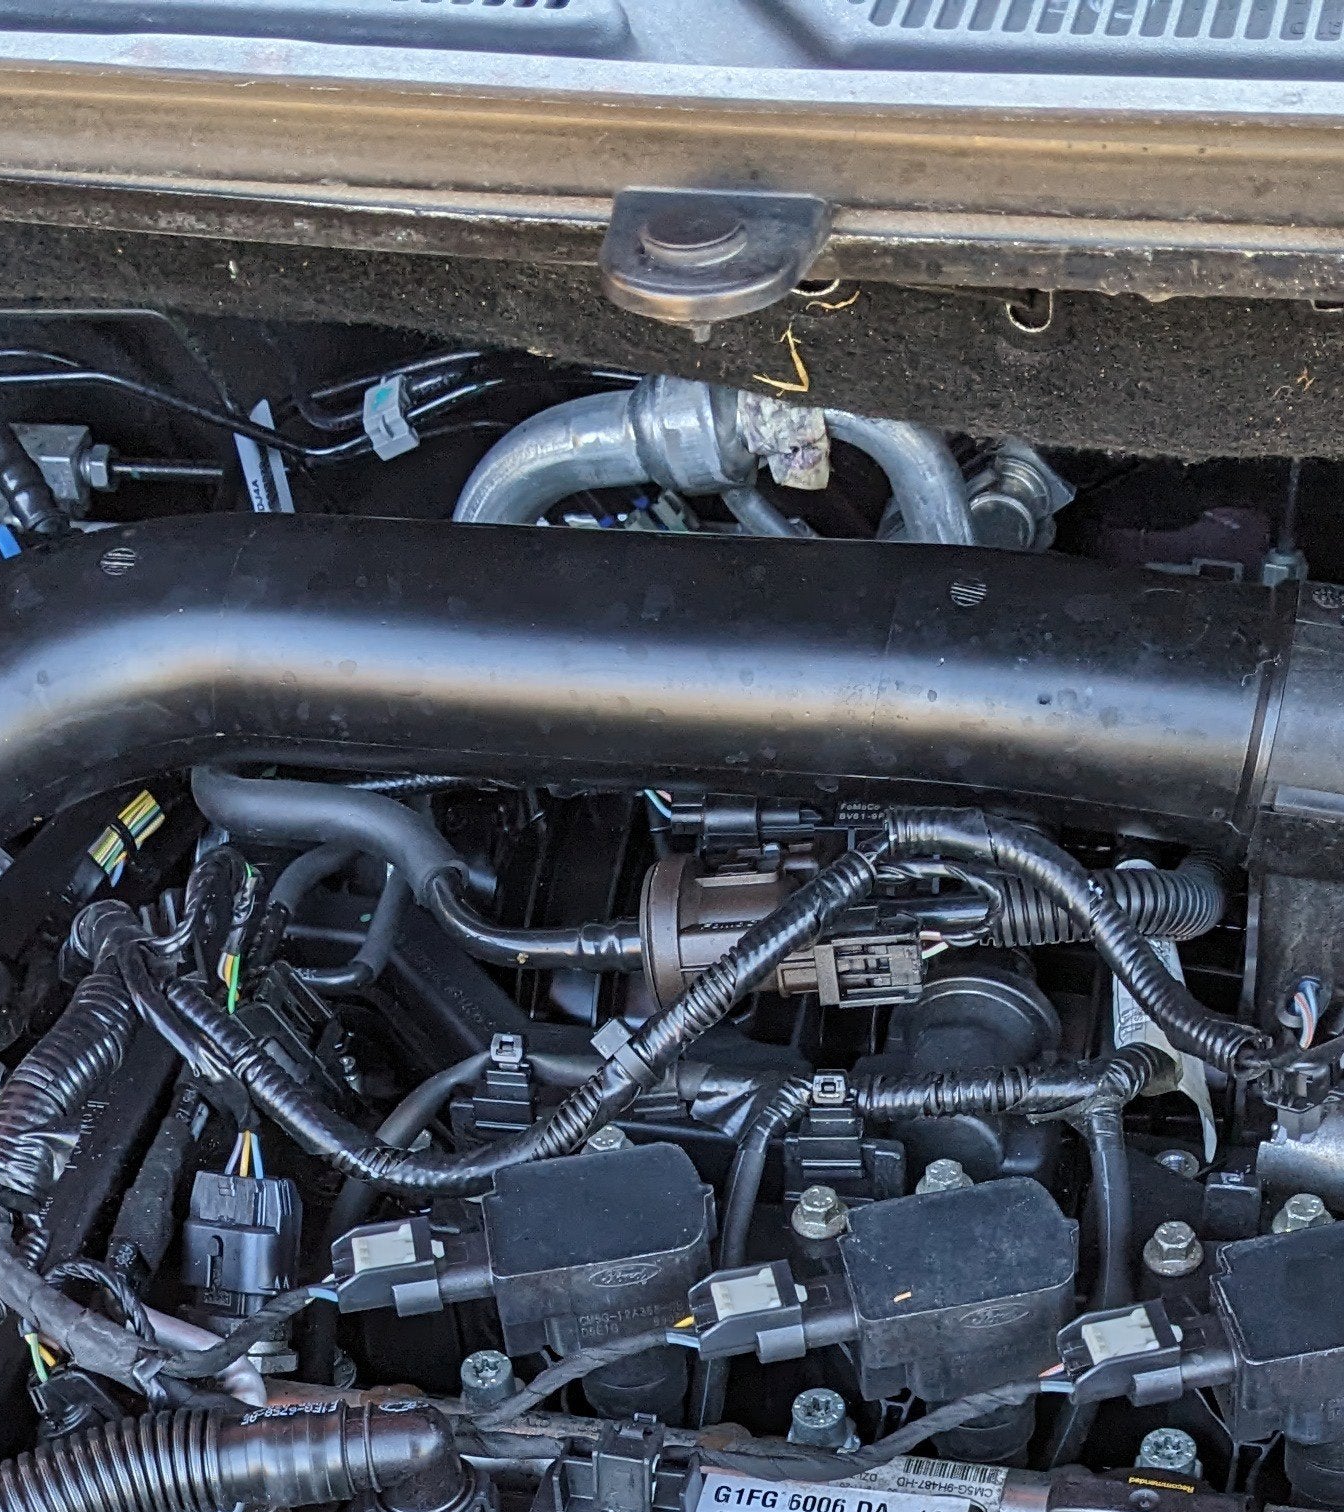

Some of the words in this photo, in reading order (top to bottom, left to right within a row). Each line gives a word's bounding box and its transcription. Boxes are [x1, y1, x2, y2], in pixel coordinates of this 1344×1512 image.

[896, 1476, 993, 1498] CM5G-9H487-HD
[1128, 1476, 1195, 1494] Recommended
[714, 1485, 779, 1508] G1FG
